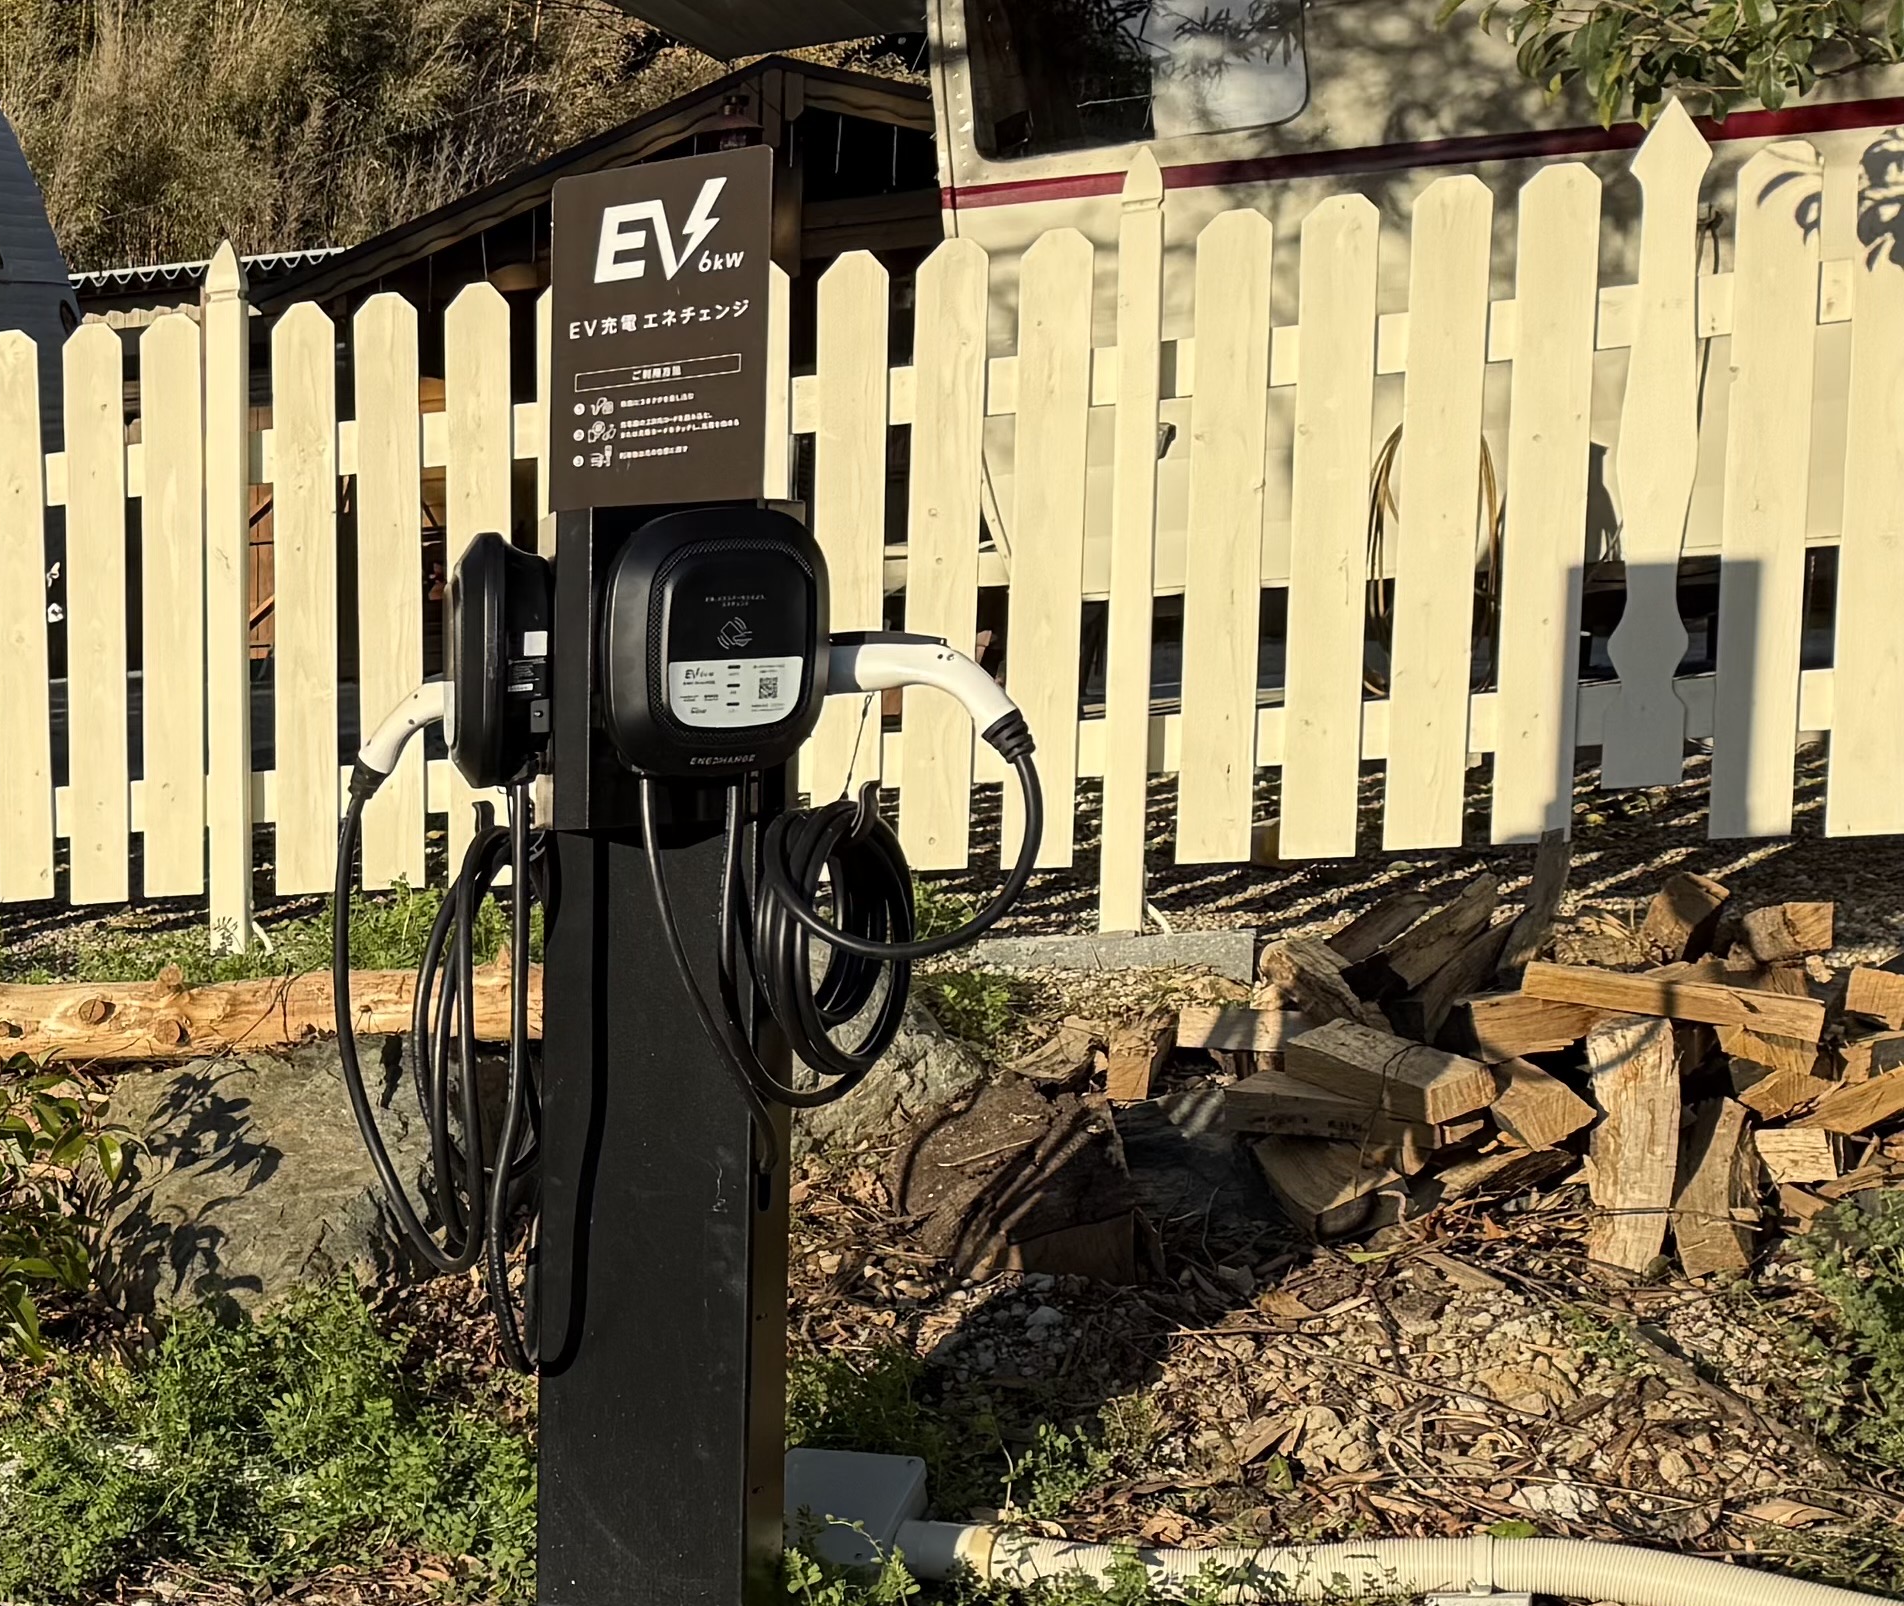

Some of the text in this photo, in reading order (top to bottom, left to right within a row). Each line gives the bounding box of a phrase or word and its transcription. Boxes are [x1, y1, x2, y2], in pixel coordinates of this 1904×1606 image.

[594, 177, 745, 283] EV 6kW
[569, 299, 750, 340] EV充電 エネチェンジ
